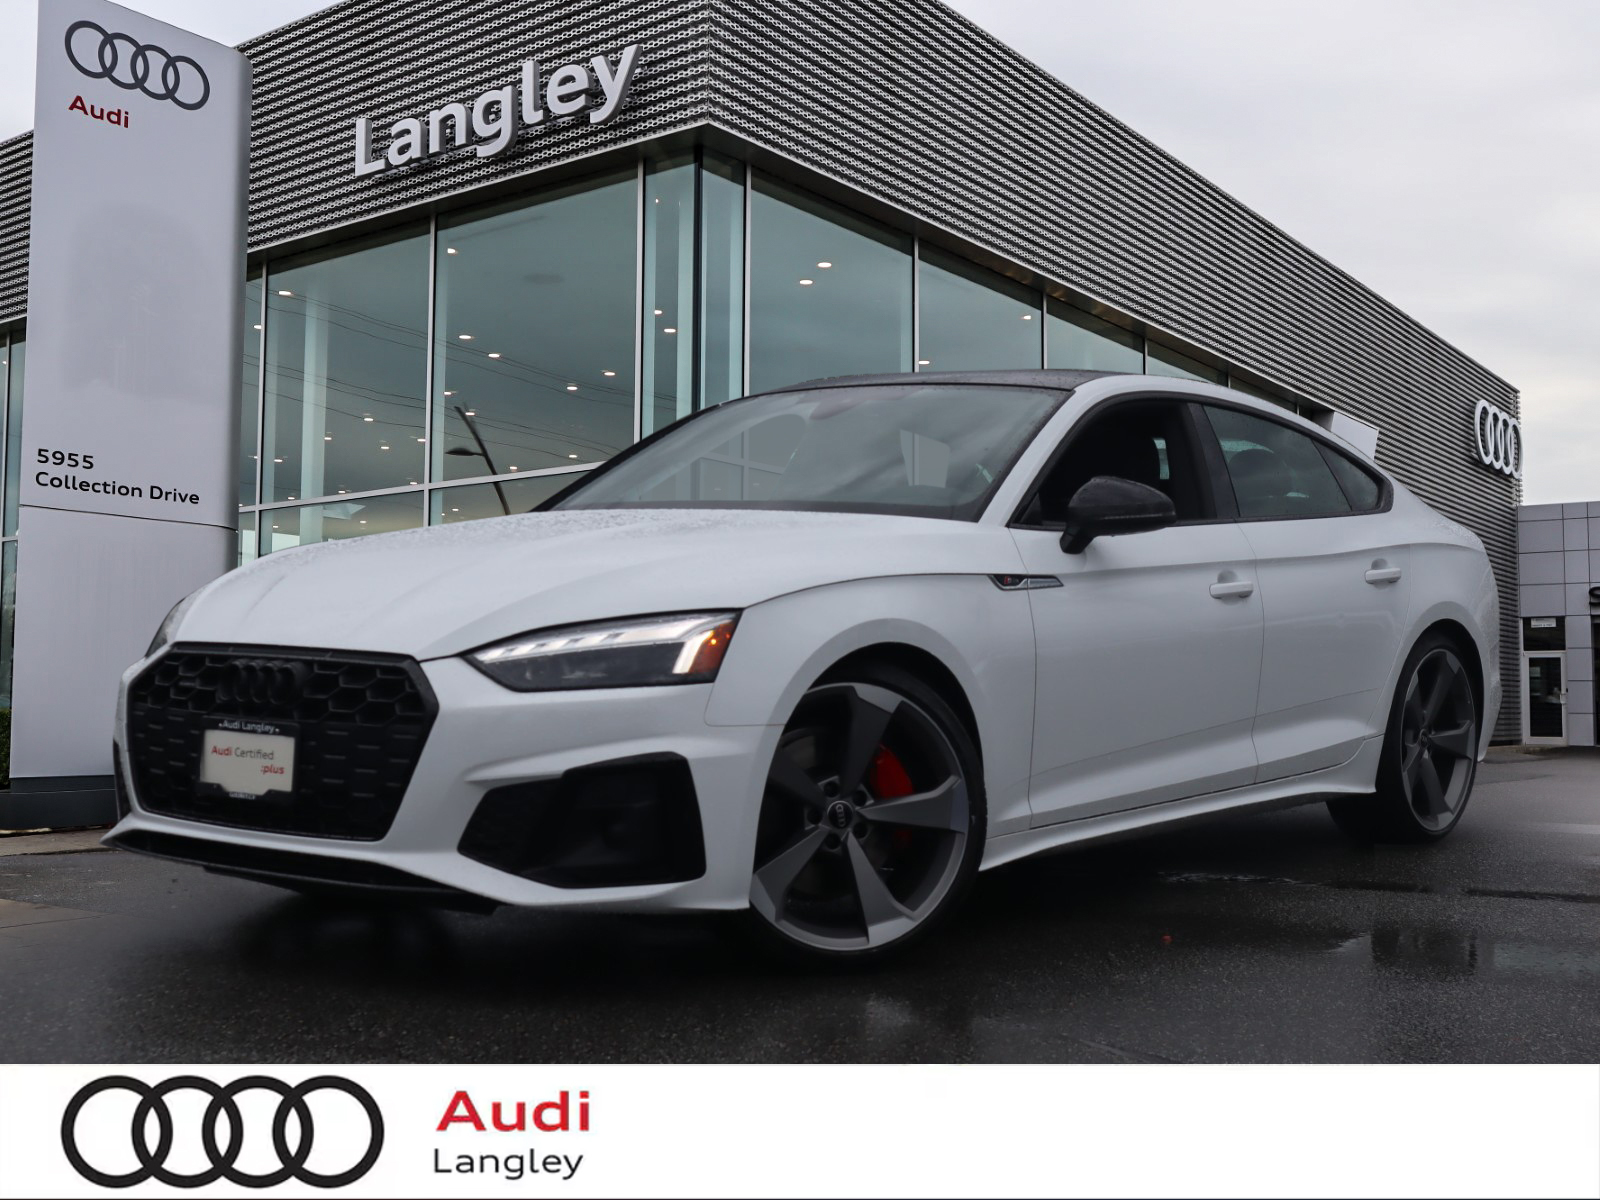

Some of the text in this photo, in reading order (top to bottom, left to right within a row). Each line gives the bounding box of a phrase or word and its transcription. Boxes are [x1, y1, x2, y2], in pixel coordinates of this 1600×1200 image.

[68, 94, 129, 128] Audi
[354, 44, 642, 177] Langley
[37, 448, 94, 469] 5955
[35, 471, 200, 504] Collection Drive
[222, 720, 275, 734] Audi Langley
[211, 746, 274, 760] Audi Certified
